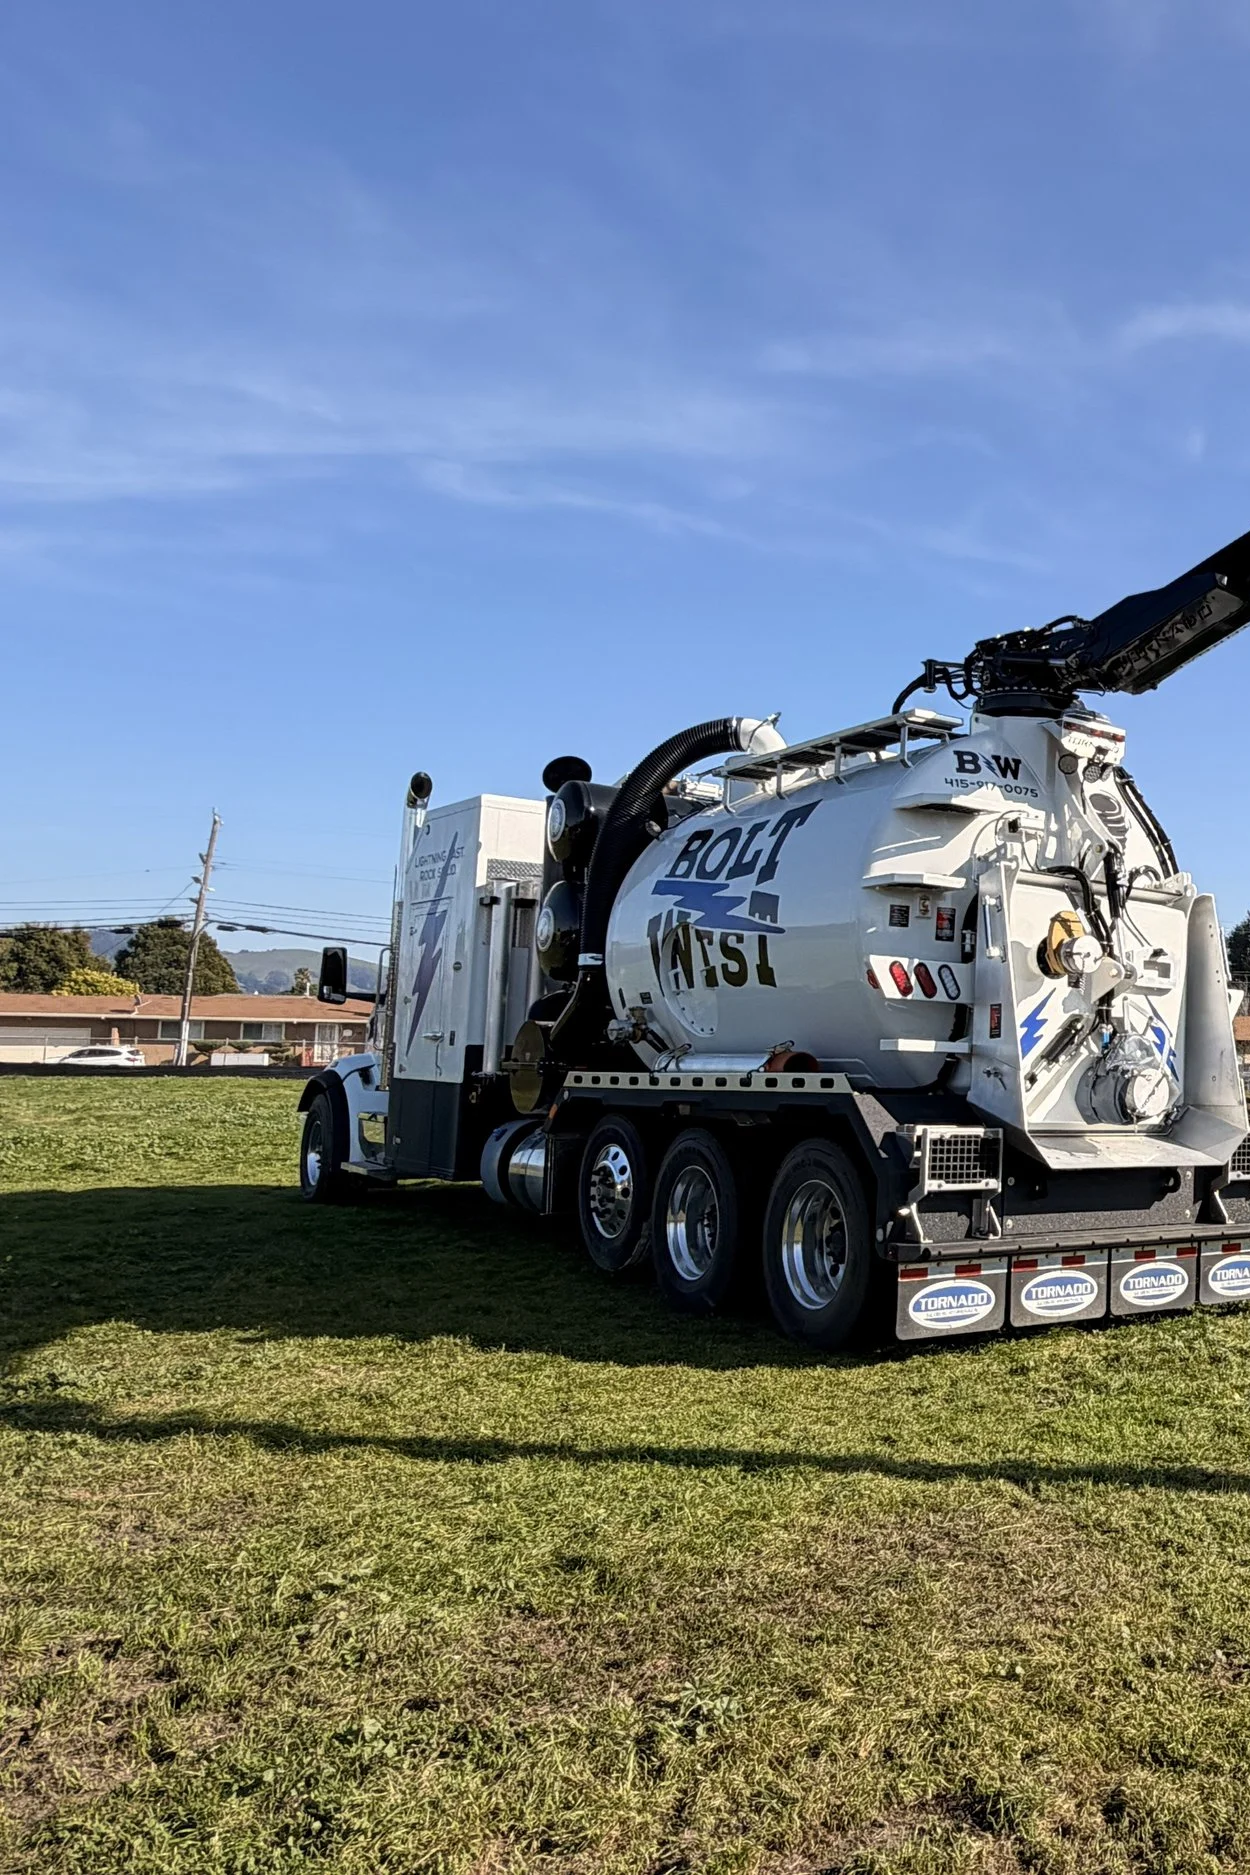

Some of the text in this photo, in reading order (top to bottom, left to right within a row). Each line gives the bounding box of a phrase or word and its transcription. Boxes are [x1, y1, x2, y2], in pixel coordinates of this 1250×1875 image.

[664, 799, 823, 886] BOLT
[1128, 1273, 1183, 1289] TORNADO
[1030, 1282, 1092, 1300] TORNADO
[919, 1292, 988, 1311] TORNADO
